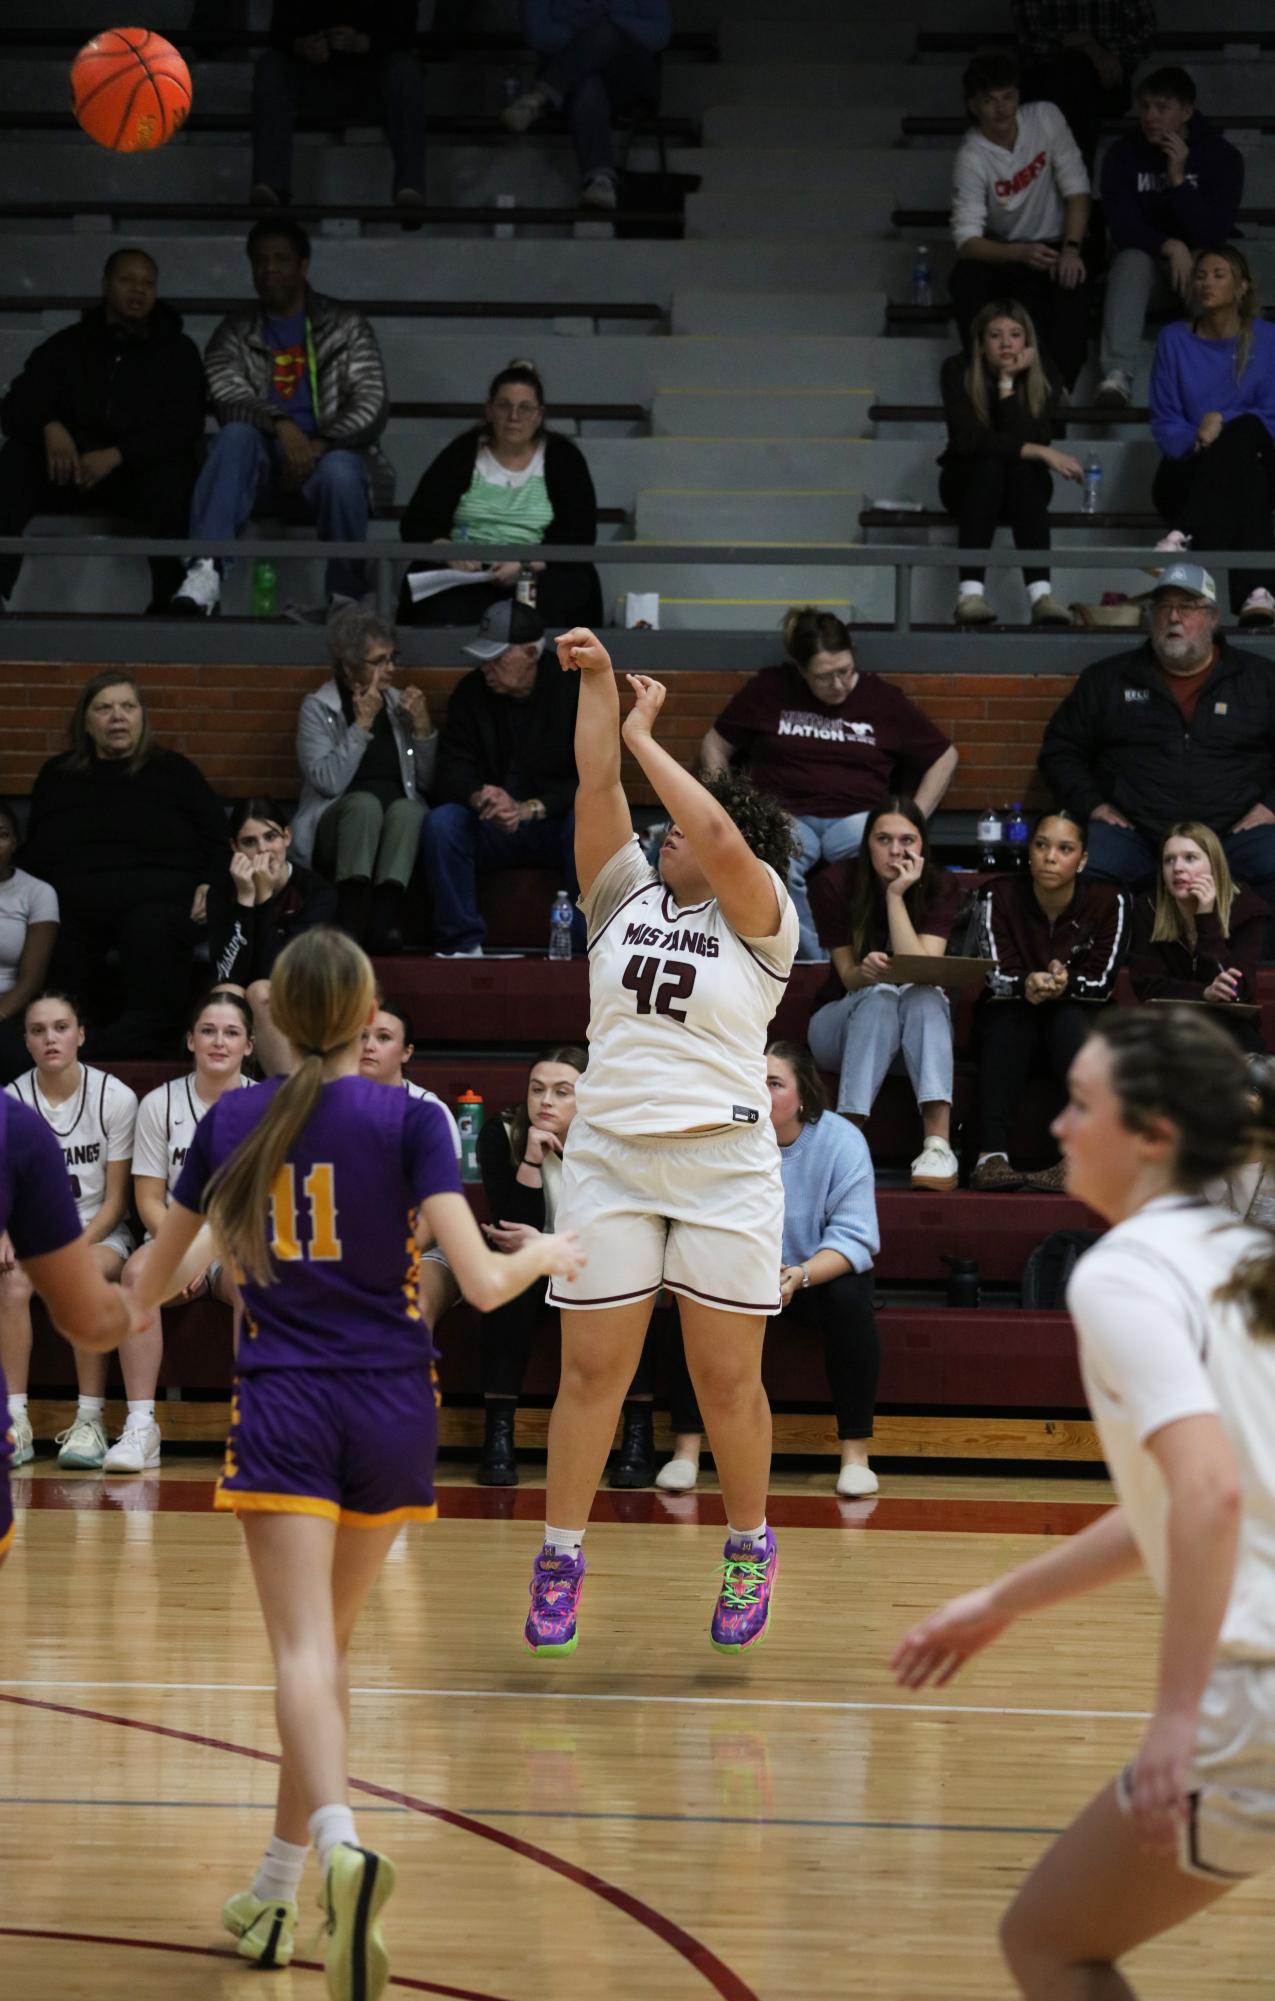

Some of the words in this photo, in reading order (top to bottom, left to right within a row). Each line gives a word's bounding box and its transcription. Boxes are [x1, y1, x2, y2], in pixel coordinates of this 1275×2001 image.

[777, 719, 845, 742] NATION
[621, 923, 719, 958] MUSTANGS
[621, 954, 697, 1023] 42
[458, 1115, 472, 1136] G
[270, 1162, 342, 1262] 11
